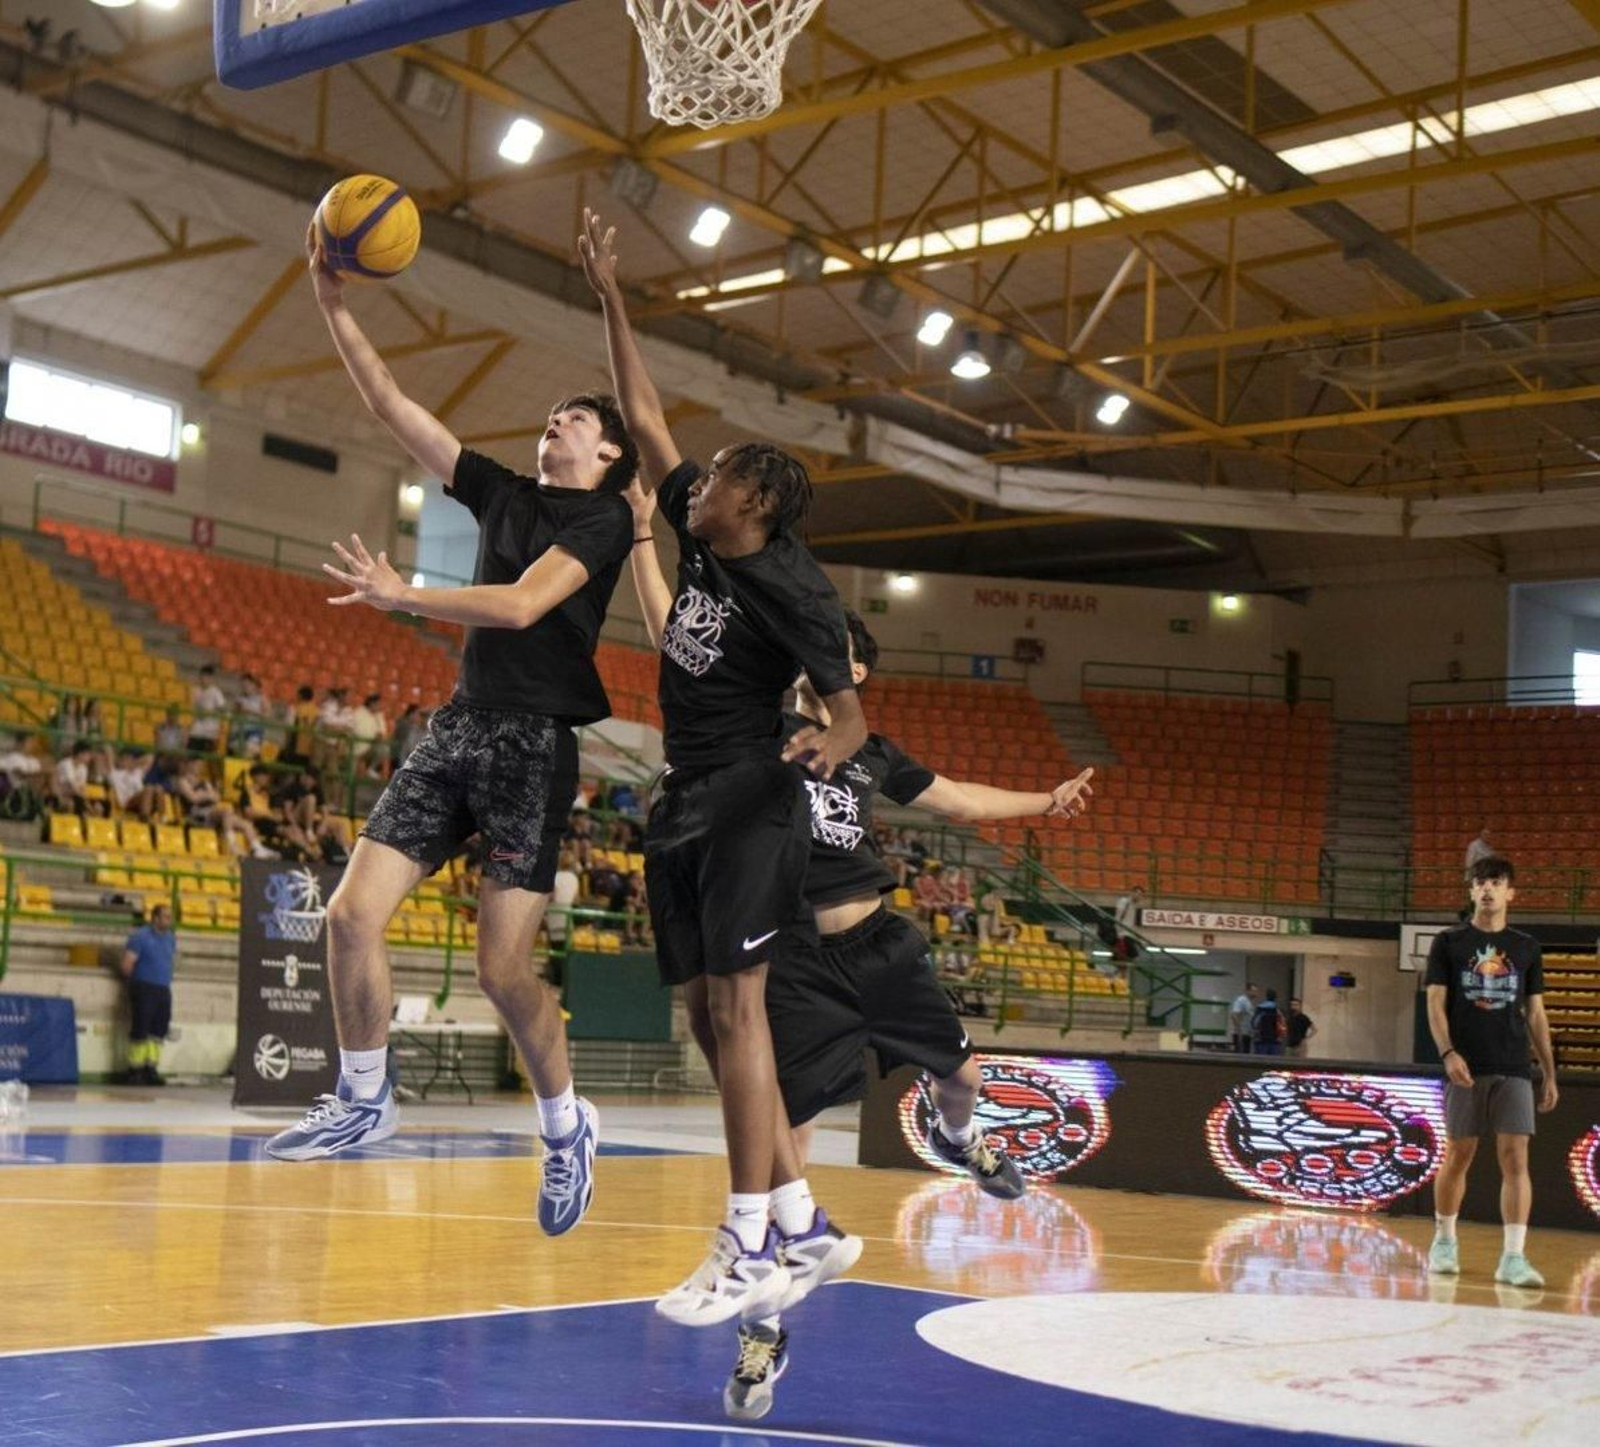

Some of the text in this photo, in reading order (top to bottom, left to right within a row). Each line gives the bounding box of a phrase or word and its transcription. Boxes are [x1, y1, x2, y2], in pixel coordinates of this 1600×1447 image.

[975, 588, 1098, 615] NON FUMAR
[980, 659, 989, 676] 1
[1199, 914, 1207, 927] E
[1215, 915, 1275, 930] ASEOS
